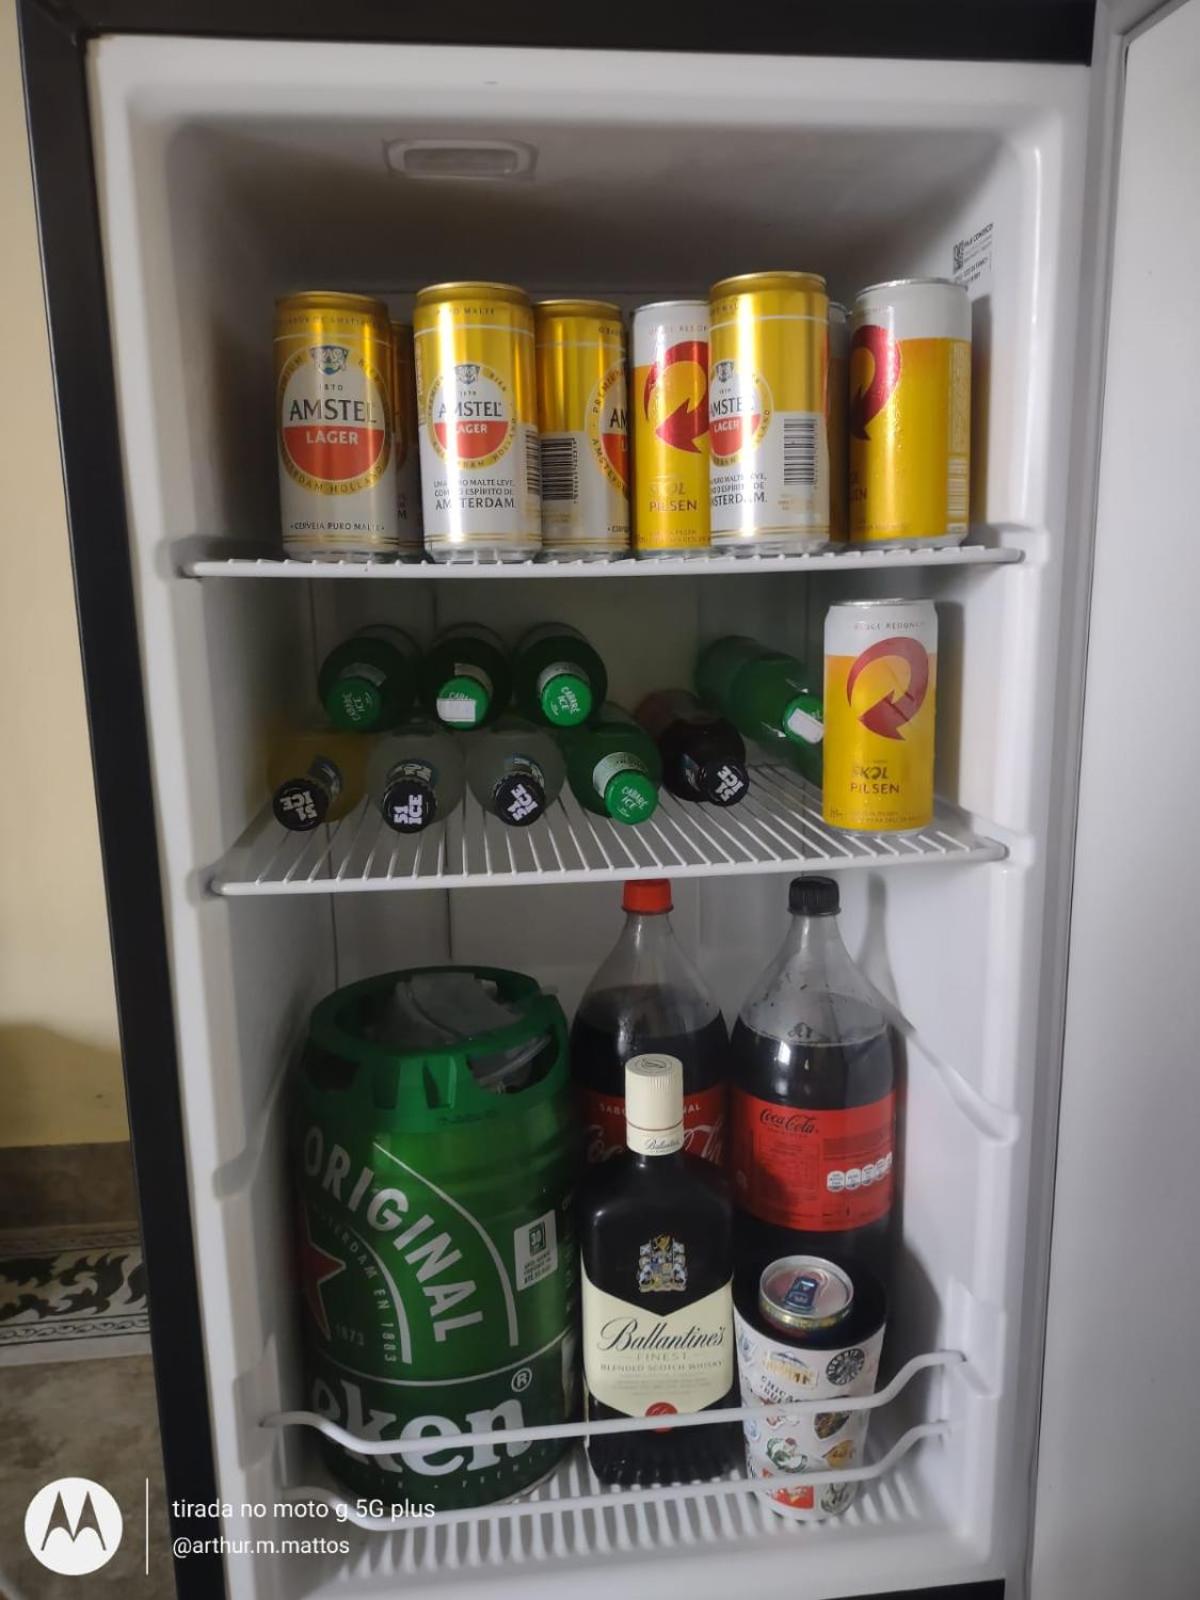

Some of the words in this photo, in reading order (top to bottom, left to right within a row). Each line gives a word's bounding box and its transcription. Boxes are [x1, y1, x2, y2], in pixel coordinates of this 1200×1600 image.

[289, 398, 377, 422] AMSTEL
[305, 430, 359, 444] LAGER
[717, 765, 745, 793] ICE
[849, 783, 900, 795] PILSEN
[280, 790, 314, 812] ICE
[408, 794, 423, 825] ICE
[510, 783, 539, 814] ICE
[304, 1125, 484, 1344] ORIGINAL
[598, 1316, 726, 1352] Ballantine's
[636, 1351, 687, 1361] FINEST
